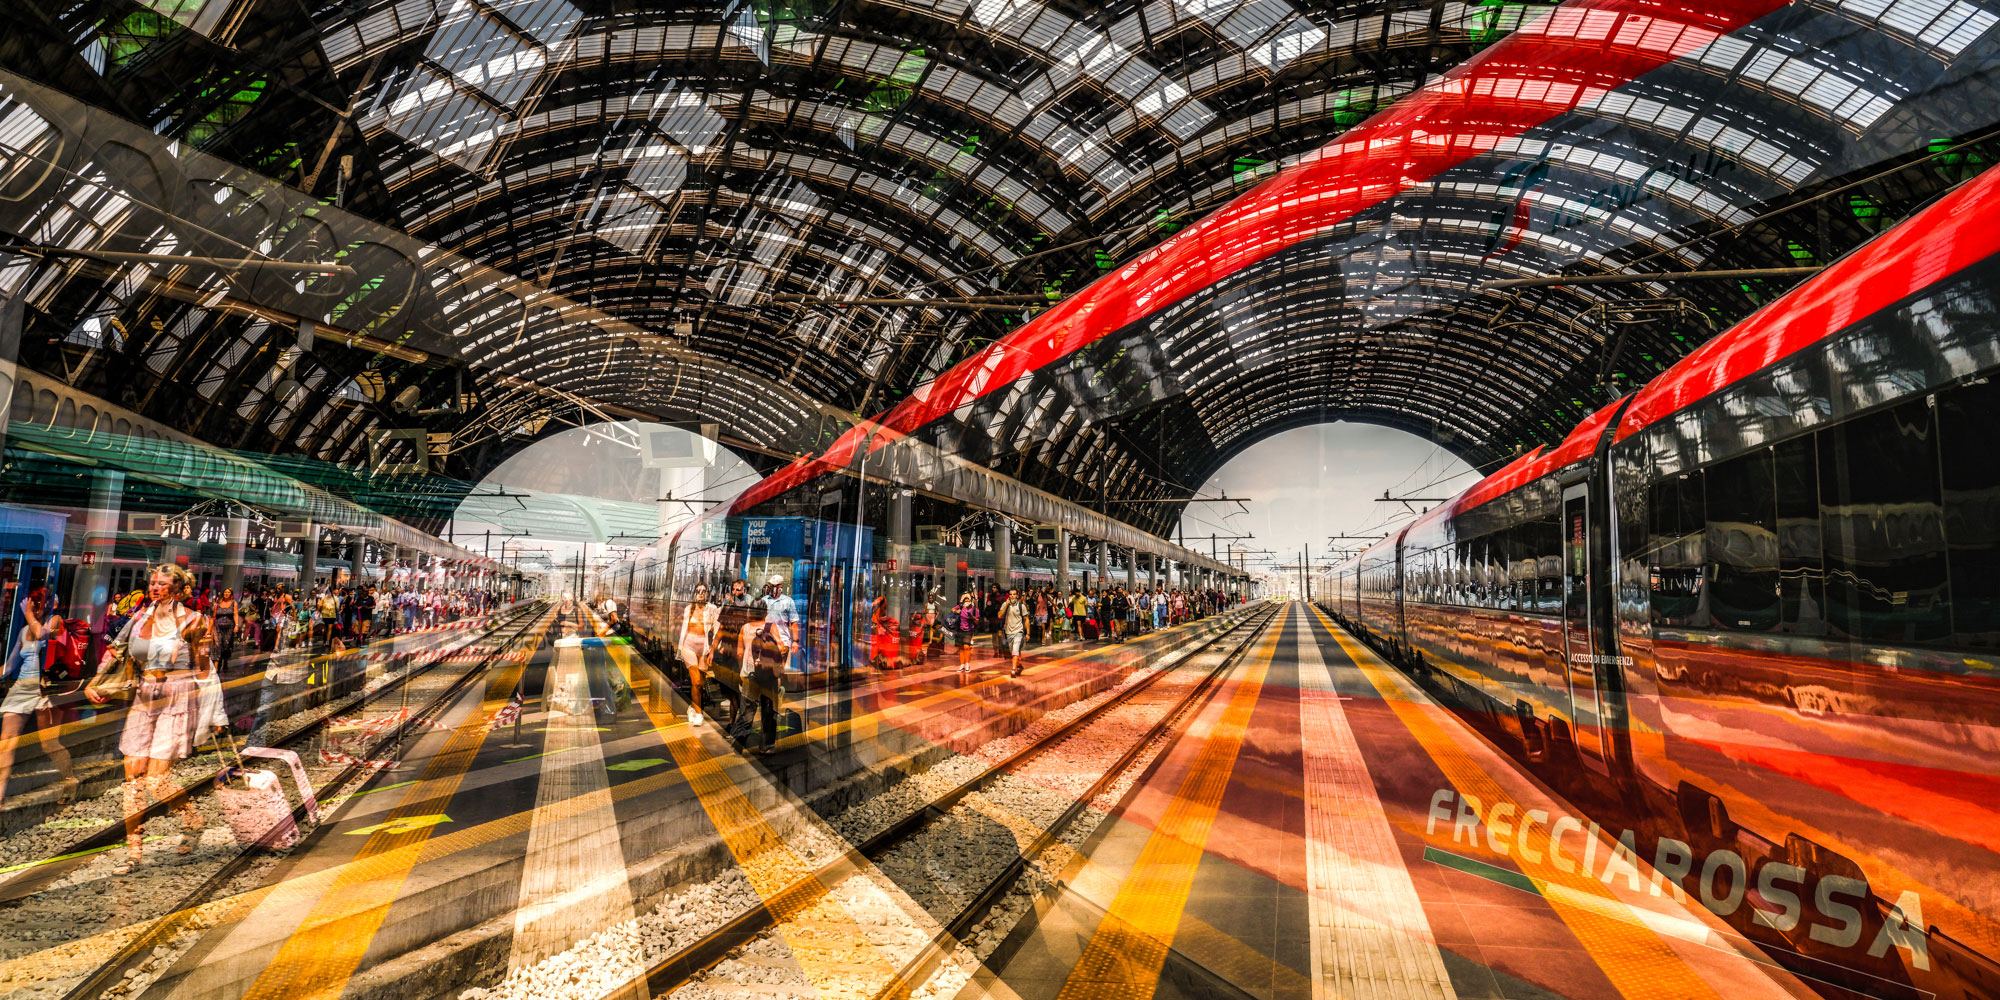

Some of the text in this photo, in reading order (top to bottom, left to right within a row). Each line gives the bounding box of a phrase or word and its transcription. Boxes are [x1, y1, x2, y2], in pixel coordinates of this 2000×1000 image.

[749, 520, 767, 528] your
[748, 528, 765, 536] best
[1571, 653, 1633, 666] ACCESSO DI EMERGENZA
[1426, 788, 1931, 972] FRECCIAROSSA
